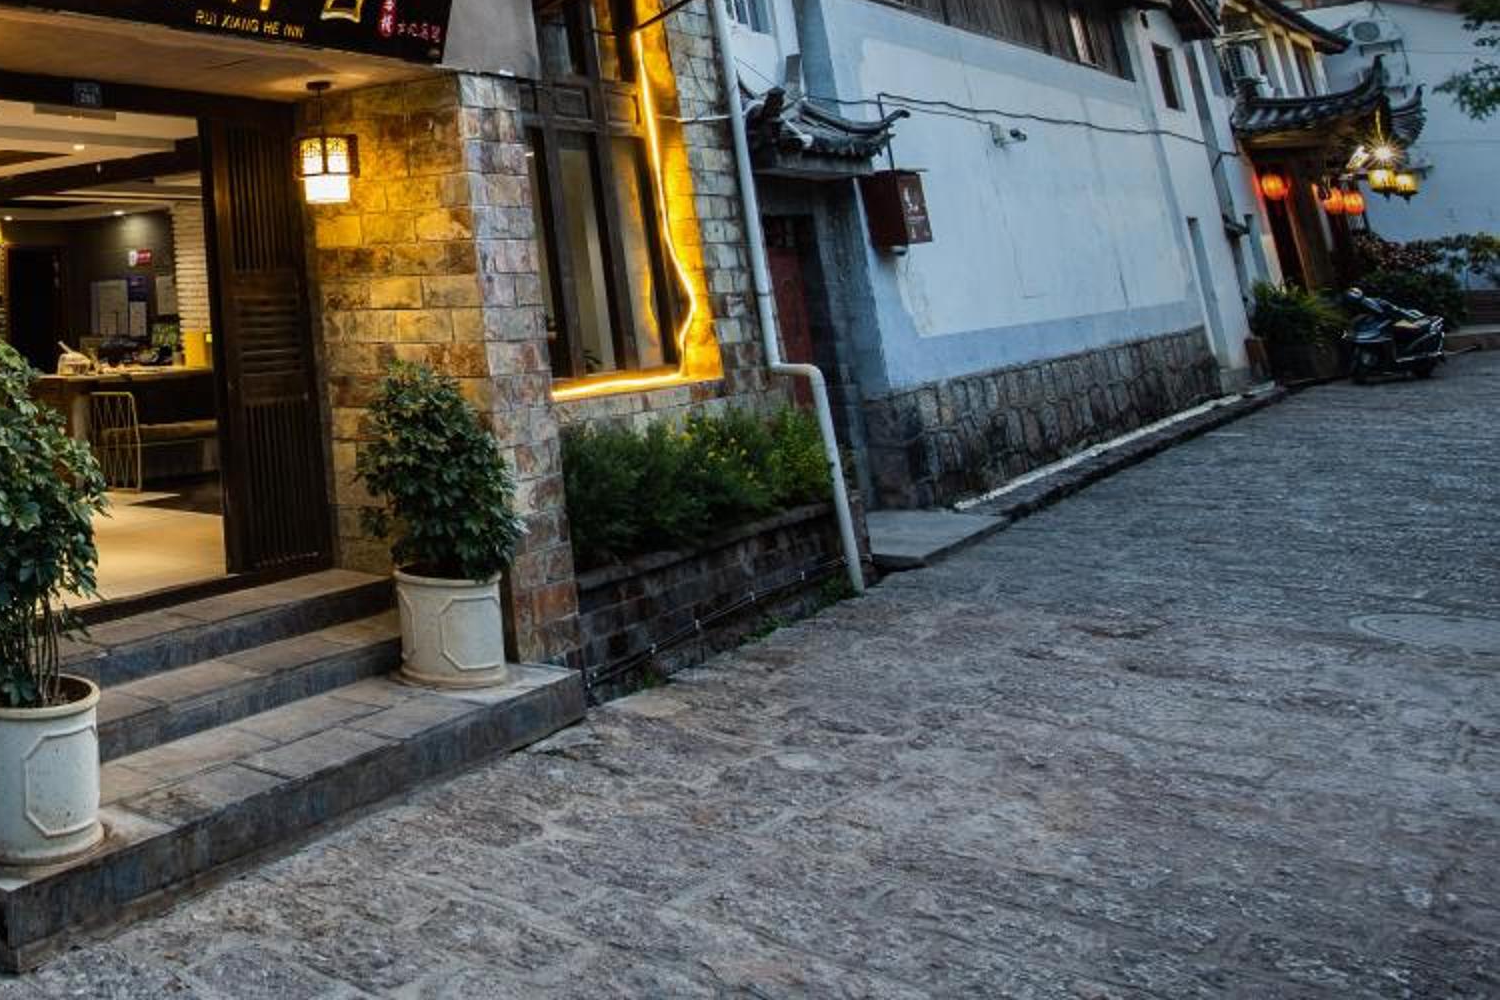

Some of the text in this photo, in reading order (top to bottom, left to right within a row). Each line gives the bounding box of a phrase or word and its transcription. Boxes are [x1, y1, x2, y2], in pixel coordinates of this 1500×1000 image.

[196, 9, 305, 39] RUI XIANG HE INN
